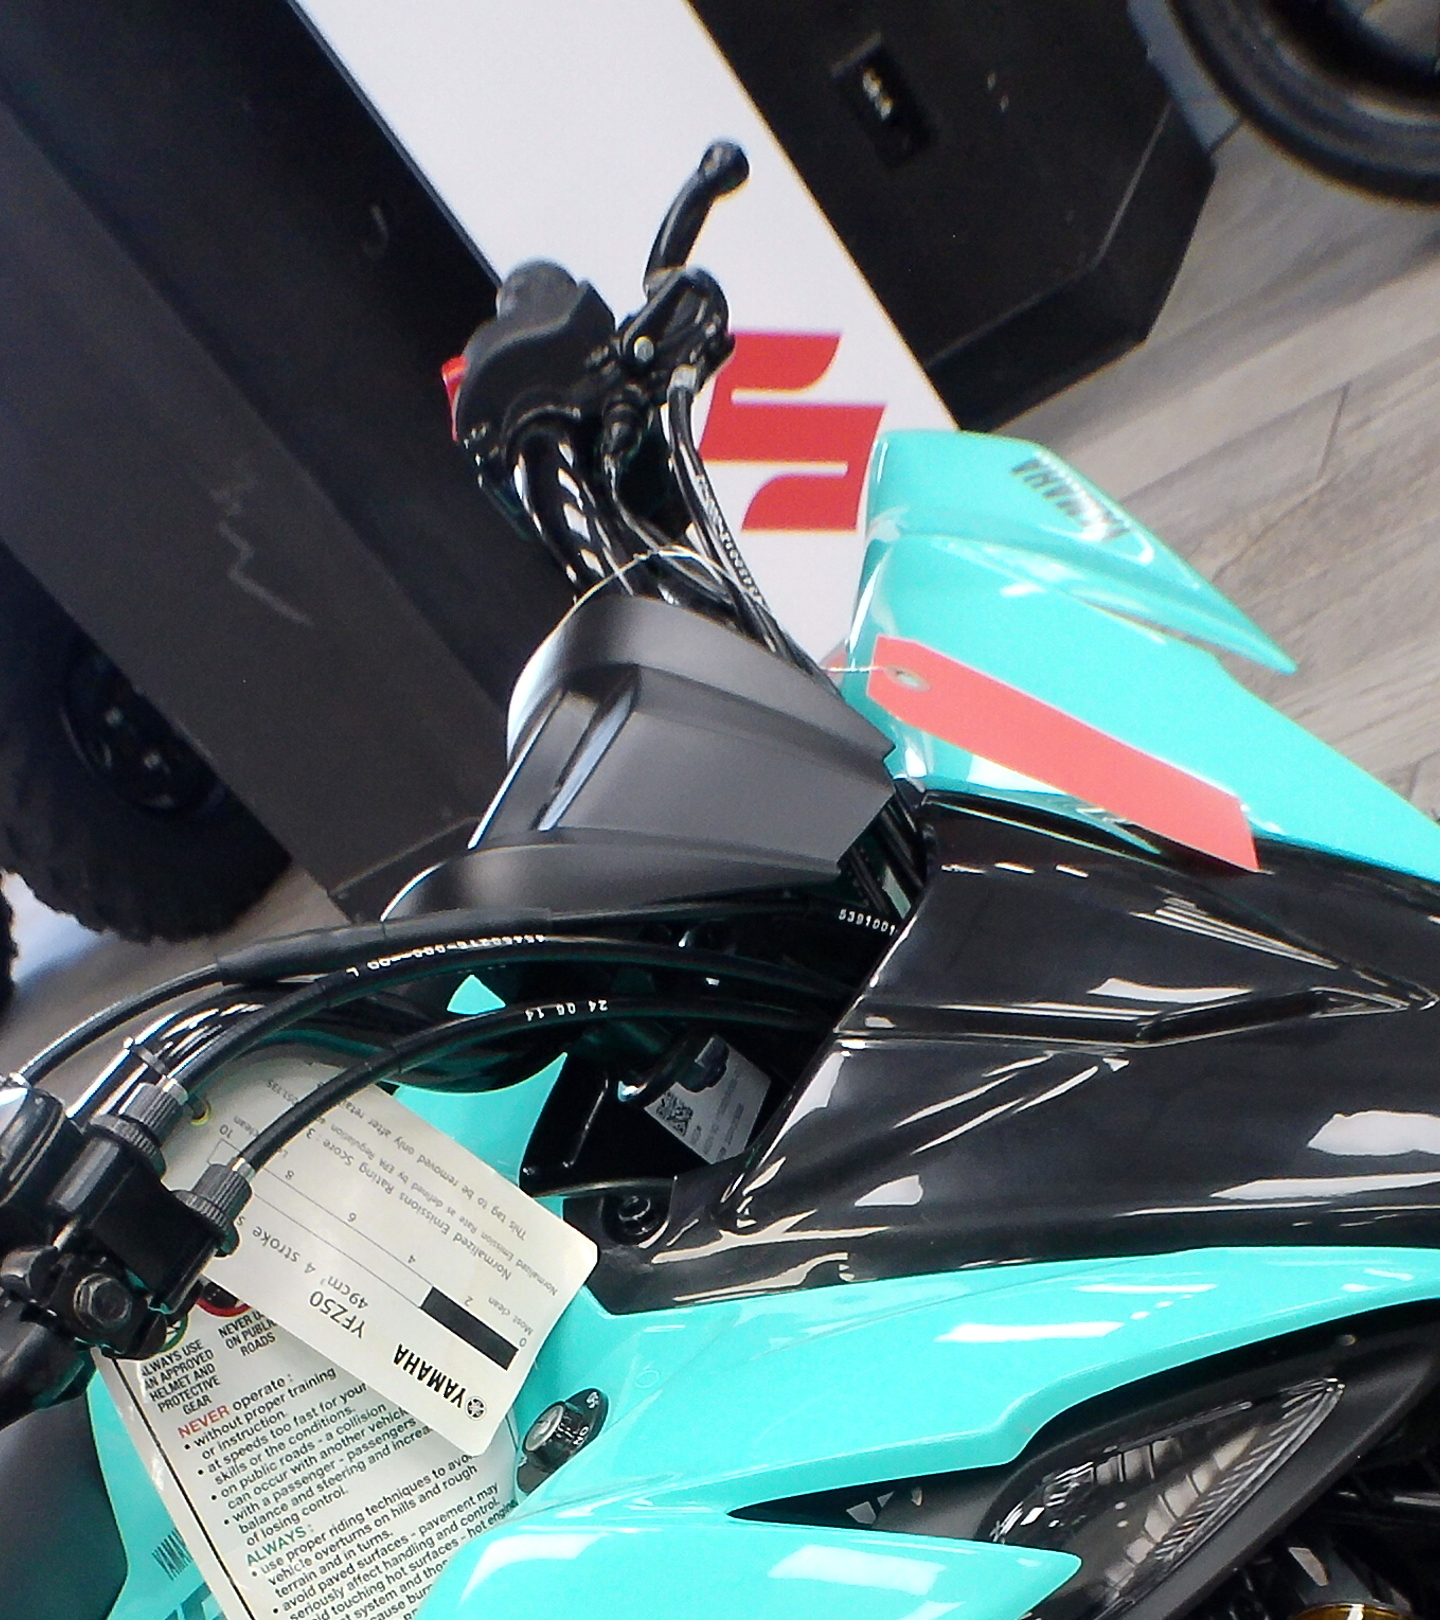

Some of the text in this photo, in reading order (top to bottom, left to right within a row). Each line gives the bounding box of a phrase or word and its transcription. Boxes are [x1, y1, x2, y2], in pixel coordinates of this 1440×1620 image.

[305, 1127, 315, 1139] 3
[329, 1122, 375, 1160] Regulation
[367, 1118, 392, 1137] after
[392, 1135, 415, 1155] only
[357, 1161, 394, 1195] Rating
[378, 1157, 395, 1174] EPA
[397, 1171, 409, 1184] by
[415, 1153, 459, 1187] removed
[409, 1181, 443, 1207] defined
[446, 1205, 456, 1216] as
[461, 1184, 474, 1200] be
[476, 1196, 487, 1209] to
[398, 1191, 450, 1235] Emissions
[458, 1215, 477, 1234] Rate
[490, 1205, 506, 1223] tag
[508, 1220, 526, 1241] This
[218, 1123, 527, 1347] 0 2 4 6 8 10
[251, 1225, 300, 1262] stroke
[480, 1231, 514, 1262] Emission
[303, 1261, 316, 1273] 4
[451, 1231, 512, 1281] Normalized
[514, 1258, 558, 1296] Normalized
[217, 1314, 253, 1338] NEVER
[308, 1290, 365, 1339] YFZ50
[487, 1296, 533, 1336] Most clean
[180, 1338, 203, 1356] USE
[224, 1333, 242, 1349] ON
[239, 1330, 276, 1356] ROADS
[144, 1348, 214, 1390] AN APPROVED
[148, 1362, 215, 1402] HELMET AND
[392, 1343, 466, 1408] YAMAHA
[156, 1374, 220, 1413] PROTECTIVE
[176, 1404, 230, 1439] NEVER
[231, 1377, 285, 1411] operate
[182, 1393, 212, 1415] GEAR
[192, 1367, 336, 1447] without proper training
[207, 1382, 367, 1473] at speeds too fast for your
[214, 1402, 356, 1485] skills or the conditions.
[201, 1446, 215, 1459] or
[220, 1483, 238, 1498] on
[238, 1461, 277, 1490] public
[278, 1441, 315, 1466] roads
[324, 1431, 334, 1441] a
[335, 1403, 387, 1435] collision
[227, 1491, 252, 1509] can
[252, 1470, 287, 1495] occur
[289, 1455, 318, 1474] with
[318, 1428, 365, 1459] another
[231, 1501, 260, 1522] with
[261, 1496, 271, 1507] a
[271, 1459, 335, 1503] passenger
[345, 1417, 416, 1462] passengers
[237, 1424, 433, 1534] balance and steering and increa
[246, 1484, 348, 1546] of losing control.
[260, 1453, 472, 1574] use proper riding techniques to avo
[267, 1464, 478, 1585] vehicle overturns on hills and rough
[246, 1525, 307, 1566] ALWAYS
[282, 1583, 316, 1611] avoid
[316, 1562, 356, 1594] paved
[356, 1534, 409, 1569] surfaces
[417, 1495, 476, 1537] pavement
[475, 1481, 498, 1501] may
[345, 1564, 383, 1591] affect
[381, 1535, 435, 1570] handling
[435, 1519, 459, 1540] and
[459, 1495, 504, 1526] control.
[274, 1529, 393, 1598] terrain and in turns.
[330, 1580, 386, 1615] touching
[384, 1565, 408, 1585] hot
[407, 1538, 459, 1572] surfaces
[466, 1519, 487, 1538] hot
[352, 1588, 398, 1619] system
[398, 1572, 422, 1593] and
